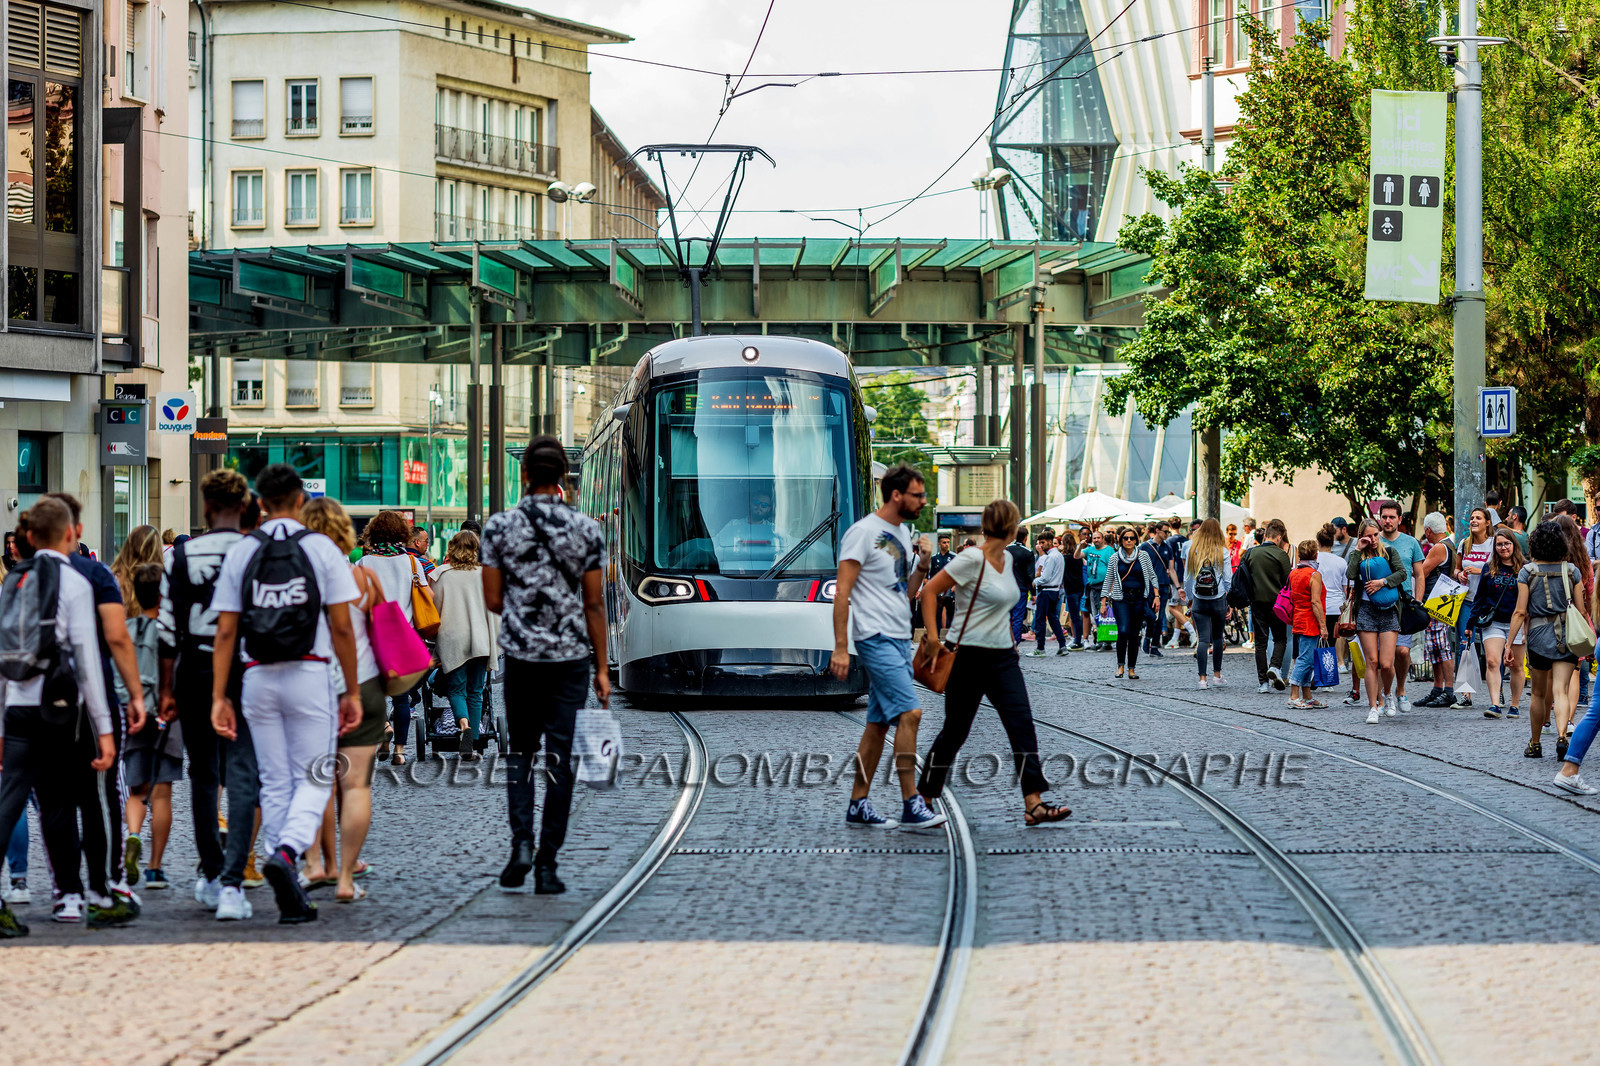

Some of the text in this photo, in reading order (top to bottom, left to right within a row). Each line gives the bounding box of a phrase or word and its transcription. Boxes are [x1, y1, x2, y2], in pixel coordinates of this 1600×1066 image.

[1397, 108, 1421, 131] ici
[1381, 136, 1436, 152] toilettes
[1374, 152, 1441, 171] publiques
[110, 410, 137, 421] CIC
[158, 422, 193, 432] bouygues
[252, 576, 308, 609] VANS
